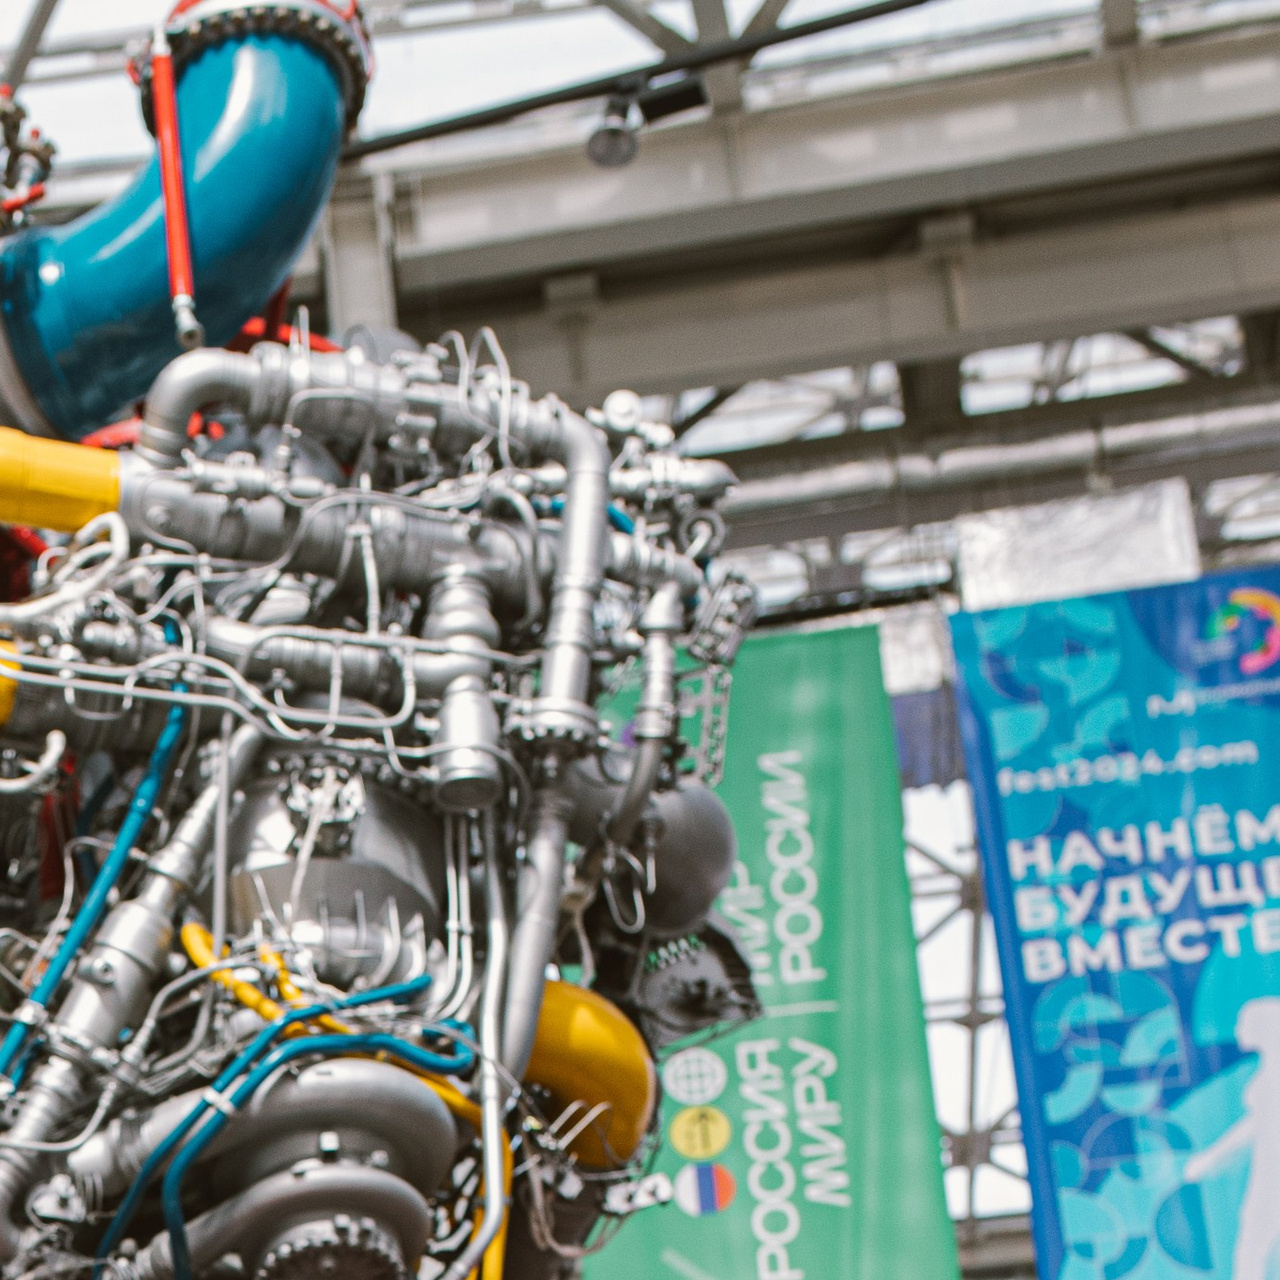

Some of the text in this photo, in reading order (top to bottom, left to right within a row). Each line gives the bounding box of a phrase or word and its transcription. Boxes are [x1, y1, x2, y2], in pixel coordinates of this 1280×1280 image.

[757, 750, 828, 984] РОССИИ
[1007, 803, 1280, 882] НАЧНЁМ
[788, 1036, 853, 1209] МИРУ
